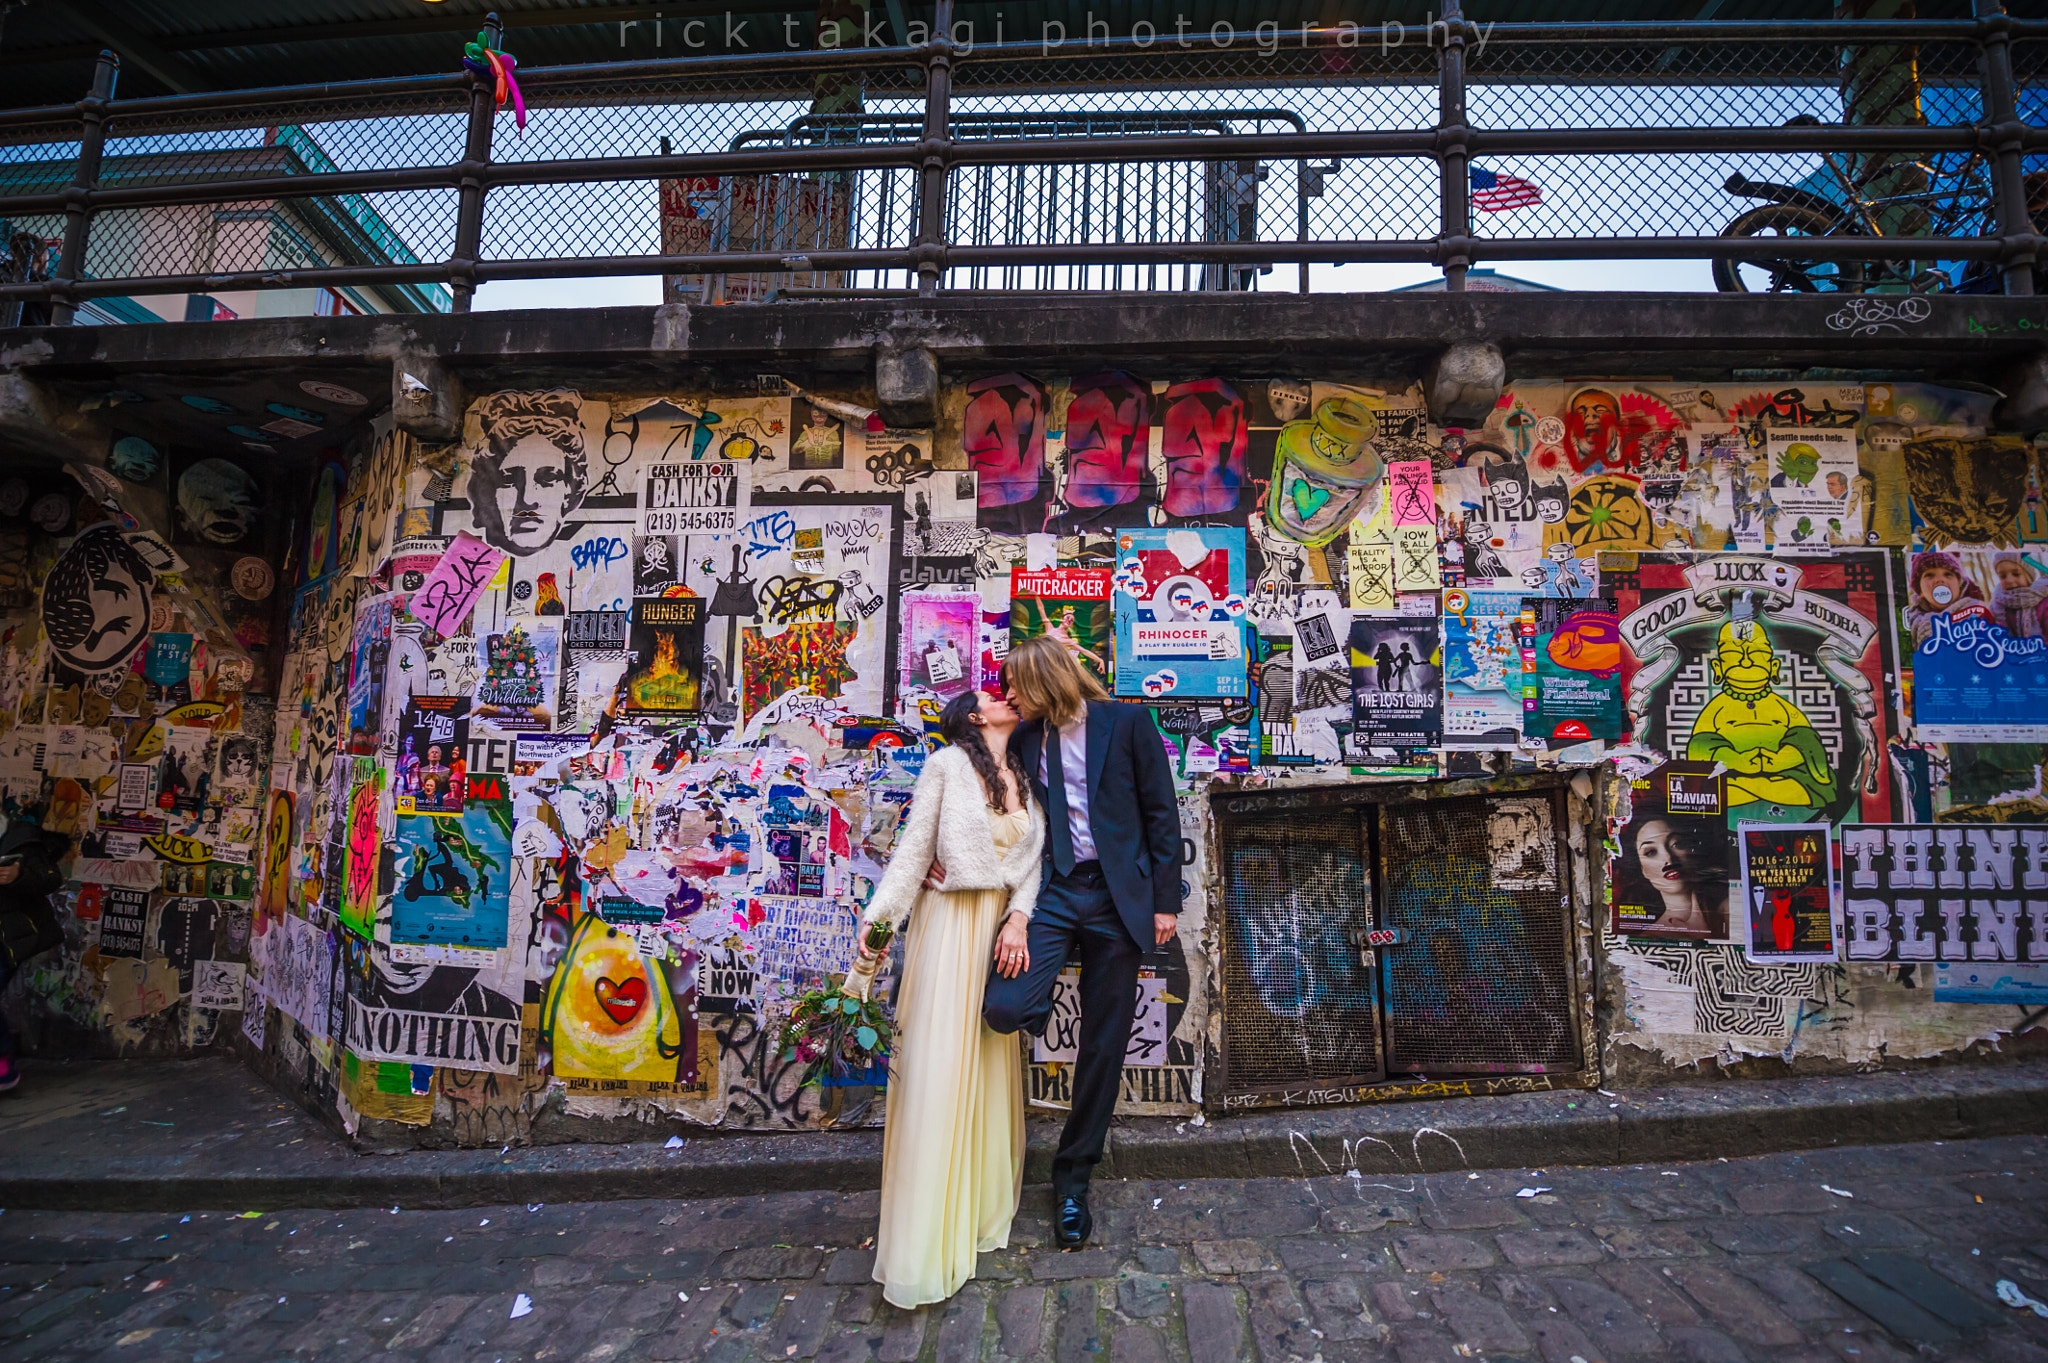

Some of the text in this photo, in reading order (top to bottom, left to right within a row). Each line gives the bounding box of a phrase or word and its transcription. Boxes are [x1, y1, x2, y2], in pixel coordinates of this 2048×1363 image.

[1387, 408, 1426, 418] FAMOUS
[1388, 417, 1426, 427] FAMS
[1770, 433, 1799, 442] Seattle
[1800, 434, 1824, 442] needs
[651, 463, 734, 478] CASH FOR YUR
[653, 476, 732, 508] BANKSY
[646, 513, 677, 534] (213)
[1056, 571, 1067, 579] THE
[1714, 563, 1768, 582] LUCK
[1017, 579, 1104, 596] NUTCRACKER
[642, 604, 696, 620] HUNGER
[1632, 597, 1863, 640] GOOD BUDDHA
[1952, 607, 1985, 621] BELLEVUE
[1923, 614, 1989, 655] Magic
[1975, 626, 2047, 668] Season
[1542, 677, 1589, 688] Winter
[482, 684, 541, 705] Wildland
[1359, 694, 1434, 708] THE LOST GIRLS
[1543, 688, 1611, 700] Fishtival
[519, 743, 534, 751] Sing
[1261, 735, 1272, 755] 2016
[1670, 781, 1682, 792] LA
[1670, 793, 1718, 805] TRAVIATA
[1750, 868, 1814, 877] NEW YEAR'S EVE
[111, 891, 144, 904] CASH
[104, 915, 144, 933] BANKSY
[360, 1007, 519, 1066] NOTHING
